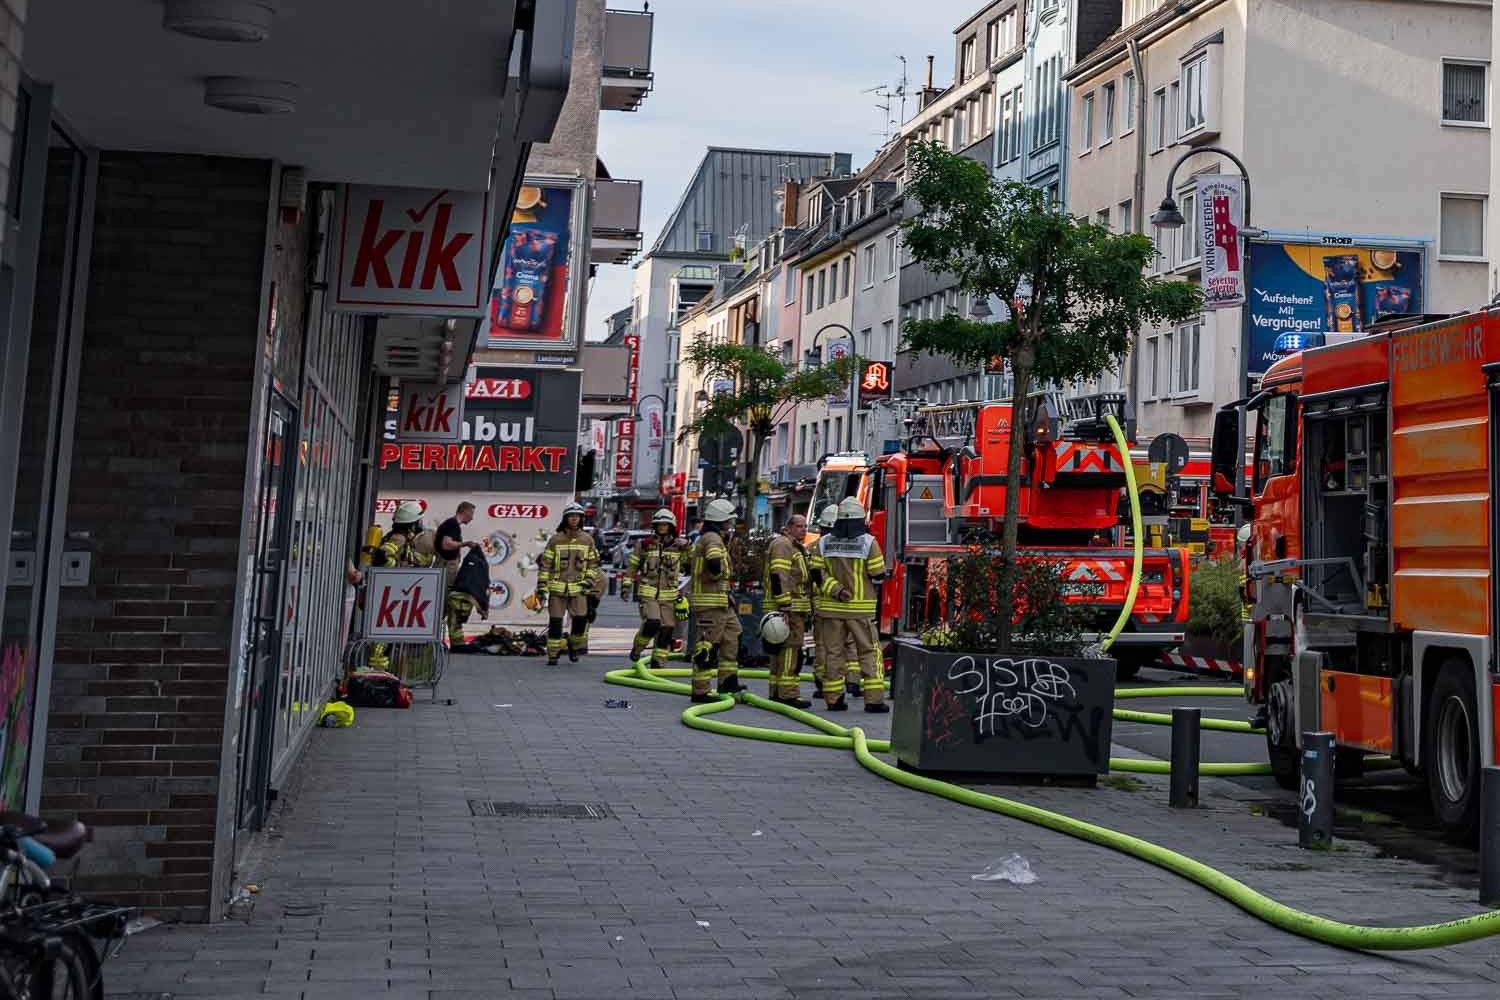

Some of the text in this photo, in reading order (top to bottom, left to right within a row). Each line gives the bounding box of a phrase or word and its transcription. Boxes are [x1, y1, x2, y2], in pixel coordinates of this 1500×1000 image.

[1203, 196, 1215, 272] VRINGSVEEDEL
[1262, 293, 1313, 305] Aufstehen?
[1279, 307, 1294, 315] Mit
[1252, 315, 1321, 332] Vergnügen!
[1393, 325, 1483, 374] FEUERWEHR
[379, 443, 567, 472] PERMARKT
[948, 655, 1076, 699] SISTER
